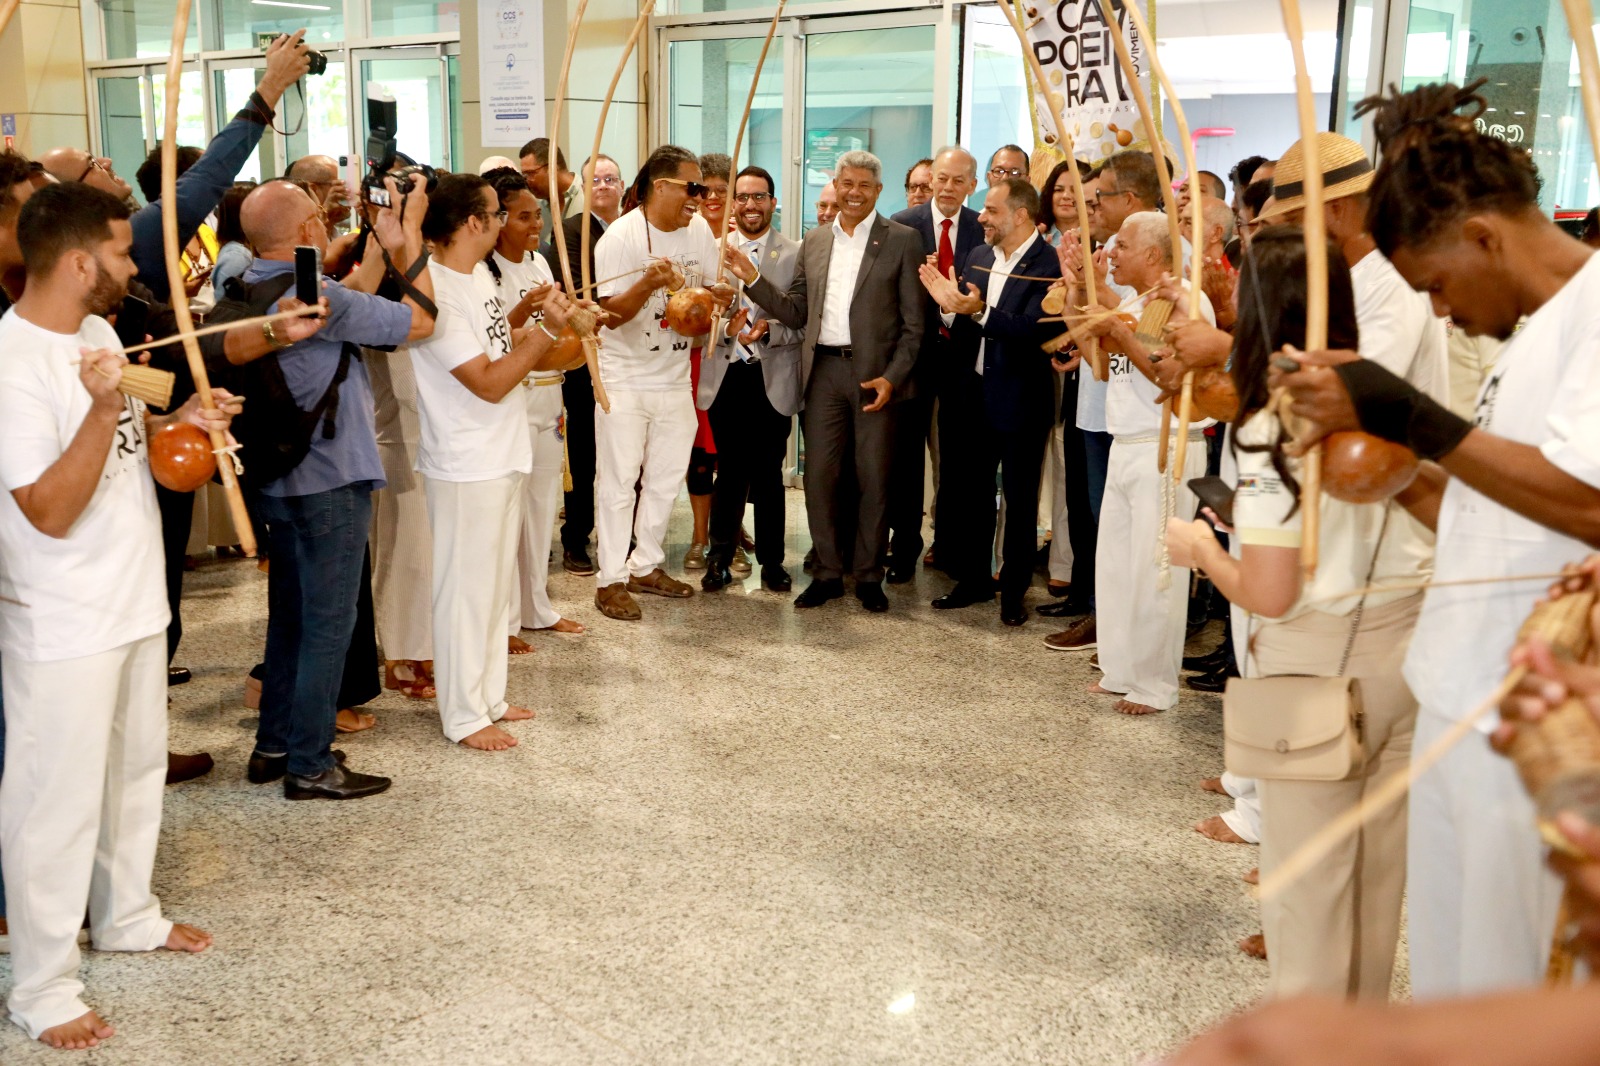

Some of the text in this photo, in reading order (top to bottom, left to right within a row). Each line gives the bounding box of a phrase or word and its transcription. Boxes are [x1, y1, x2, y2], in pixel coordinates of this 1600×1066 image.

[503, 11, 516, 20] CCS
[1057, 0, 1109, 33] CA
[1066, 69, 1109, 108] RA
